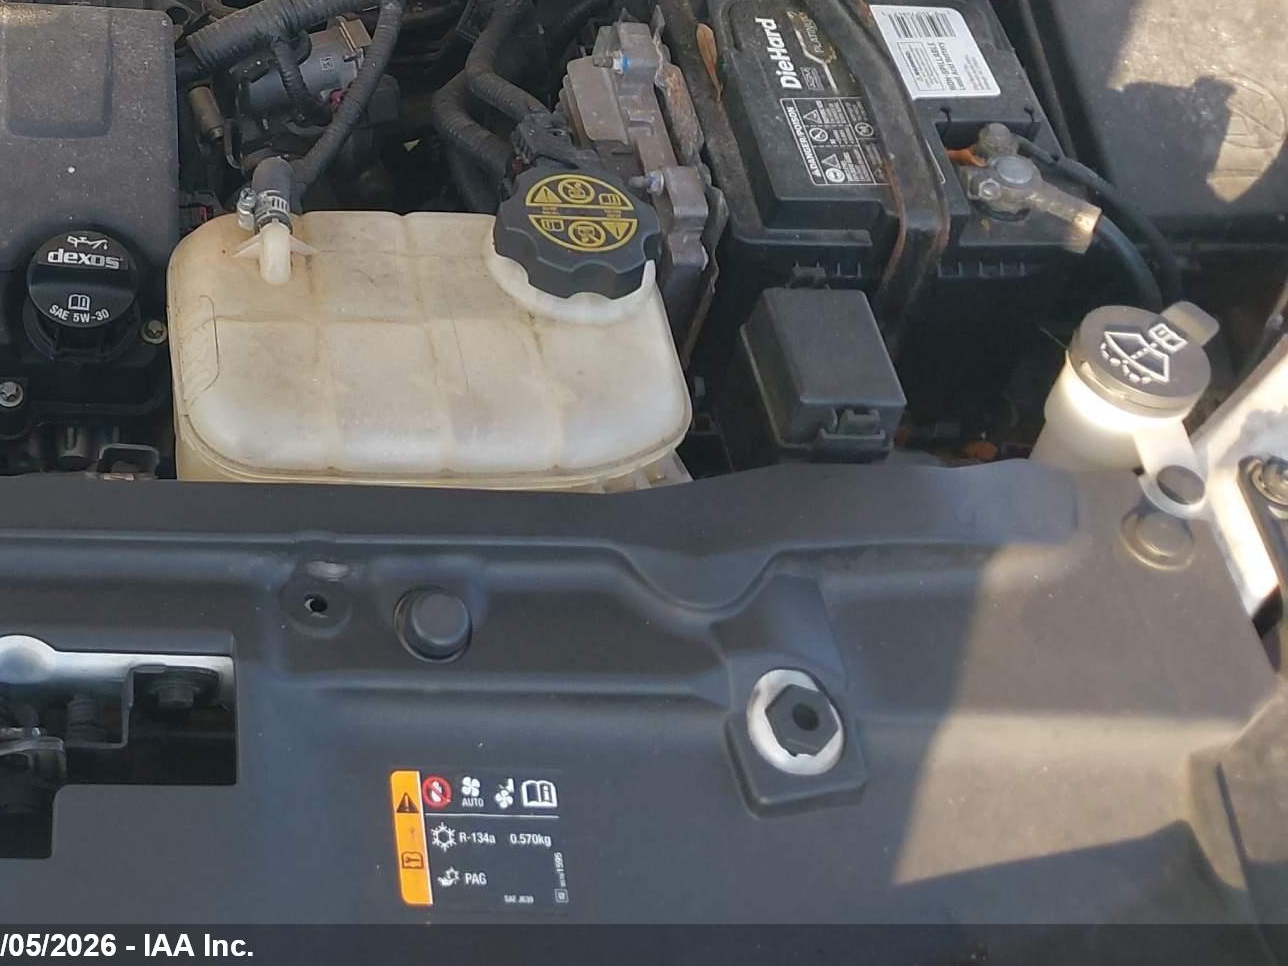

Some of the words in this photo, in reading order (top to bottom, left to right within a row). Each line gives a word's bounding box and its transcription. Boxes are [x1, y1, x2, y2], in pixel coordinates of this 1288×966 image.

[755, 17, 802, 90] DieHard
[788, 106, 817, 169] DANGER/POISON
[47, 248, 120, 269] dexos
[49, 304, 70, 321] SAE
[73, 308, 109, 322] 5W-30
[461, 797, 484, 808] AUTO
[459, 832, 496, 844] R-134a
[510, 833, 552, 847] 0.570kg
[464, 873, 487, 885] PAG
